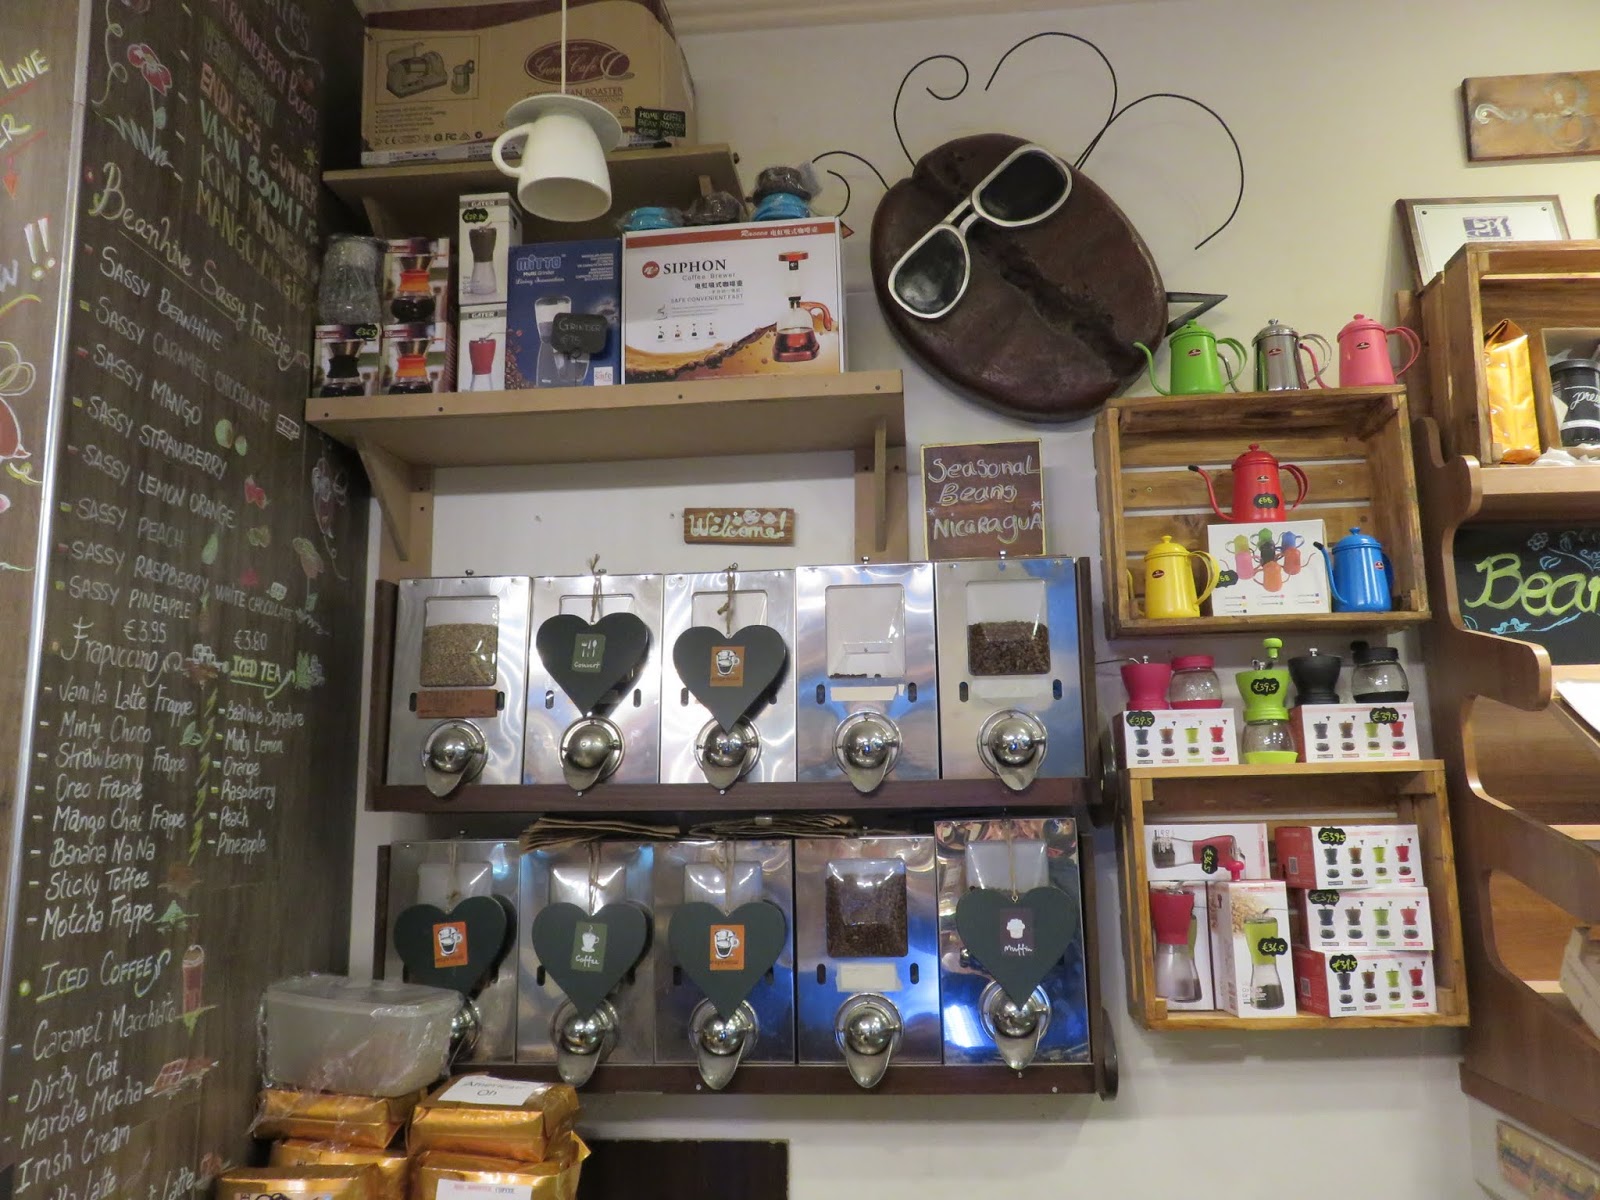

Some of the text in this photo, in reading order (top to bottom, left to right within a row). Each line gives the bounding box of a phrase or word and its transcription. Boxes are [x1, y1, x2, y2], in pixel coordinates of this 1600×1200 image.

[663, 258, 727, 275] SIPHON
[681, 272, 736, 282] Coffee Brewer
[100, 246, 224, 351] SASSY BEANHIVE
[95, 296, 145, 344] SASSY
[93, 343, 202, 427] SASSY MANGO
[87, 395, 134, 439] SASSY
[82, 444, 131, 486] SASSY
[137, 470, 187, 508] LEMON
[76, 498, 187, 548] SASSY PEACH
[71, 540, 126, 575] SASSY
[68, 575, 193, 620] SASSY PINEAPPLE
[59, 675, 107, 706] Vanilla
[260, 660, 282, 683] TEA
[59, 711, 152, 749] Minty Choco
[55, 742, 145, 785] Strawberry
[52, 805, 106, 844] Mango
[110, 806, 144, 833] Chai
[219, 805, 250, 831] Peach
[50, 838, 107, 868] Banana
[45, 867, 151, 904] Sticky Toffee
[40, 961, 89, 999] ICED
[574, 954, 601, 968] Coffee
[33, 1012, 103, 1061] Caramel
[25, 1050, 120, 1114] Dirty Chai
[21, 1099, 87, 1149] Marble
[15, 1124, 130, 1194] Irish Cream
